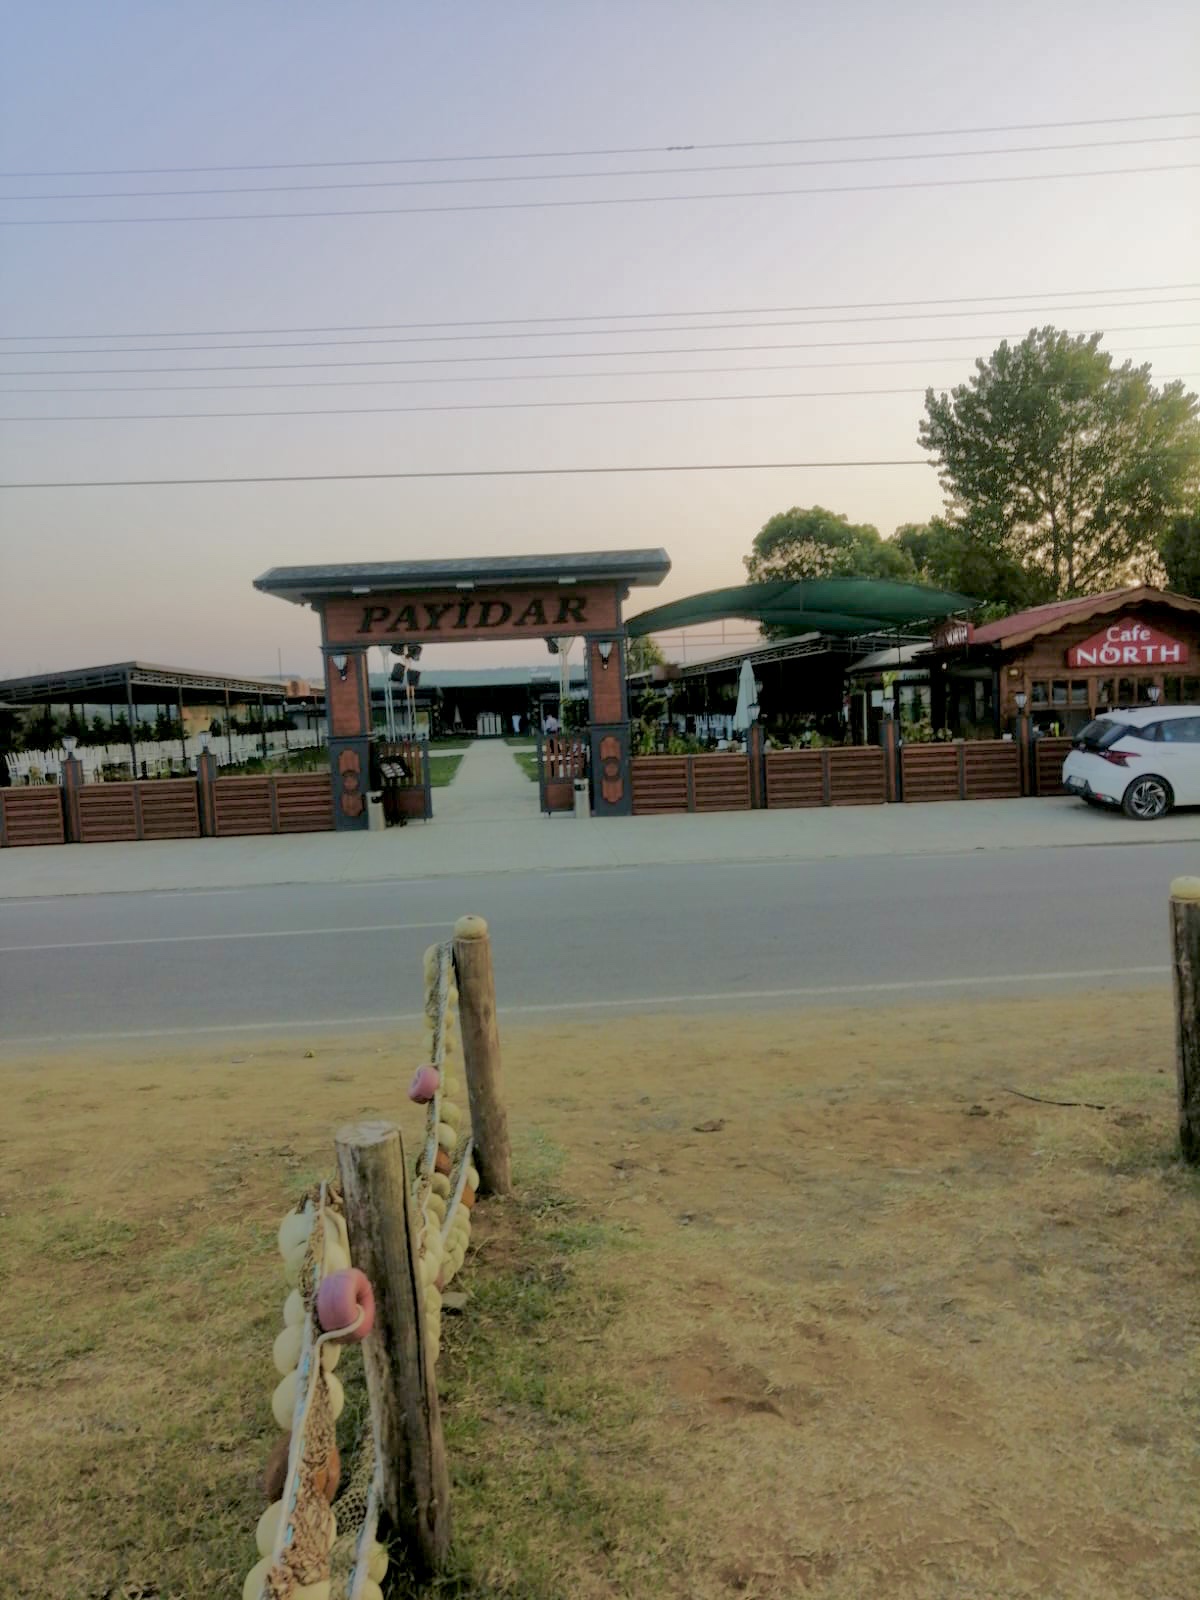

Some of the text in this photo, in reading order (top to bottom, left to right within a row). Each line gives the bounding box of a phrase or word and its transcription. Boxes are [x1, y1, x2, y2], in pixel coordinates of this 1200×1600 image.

[357, 596, 588, 633] PAYİDAR
[1106, 625, 1151, 642] Cafe
[1076, 642, 1180, 665] NORTH
